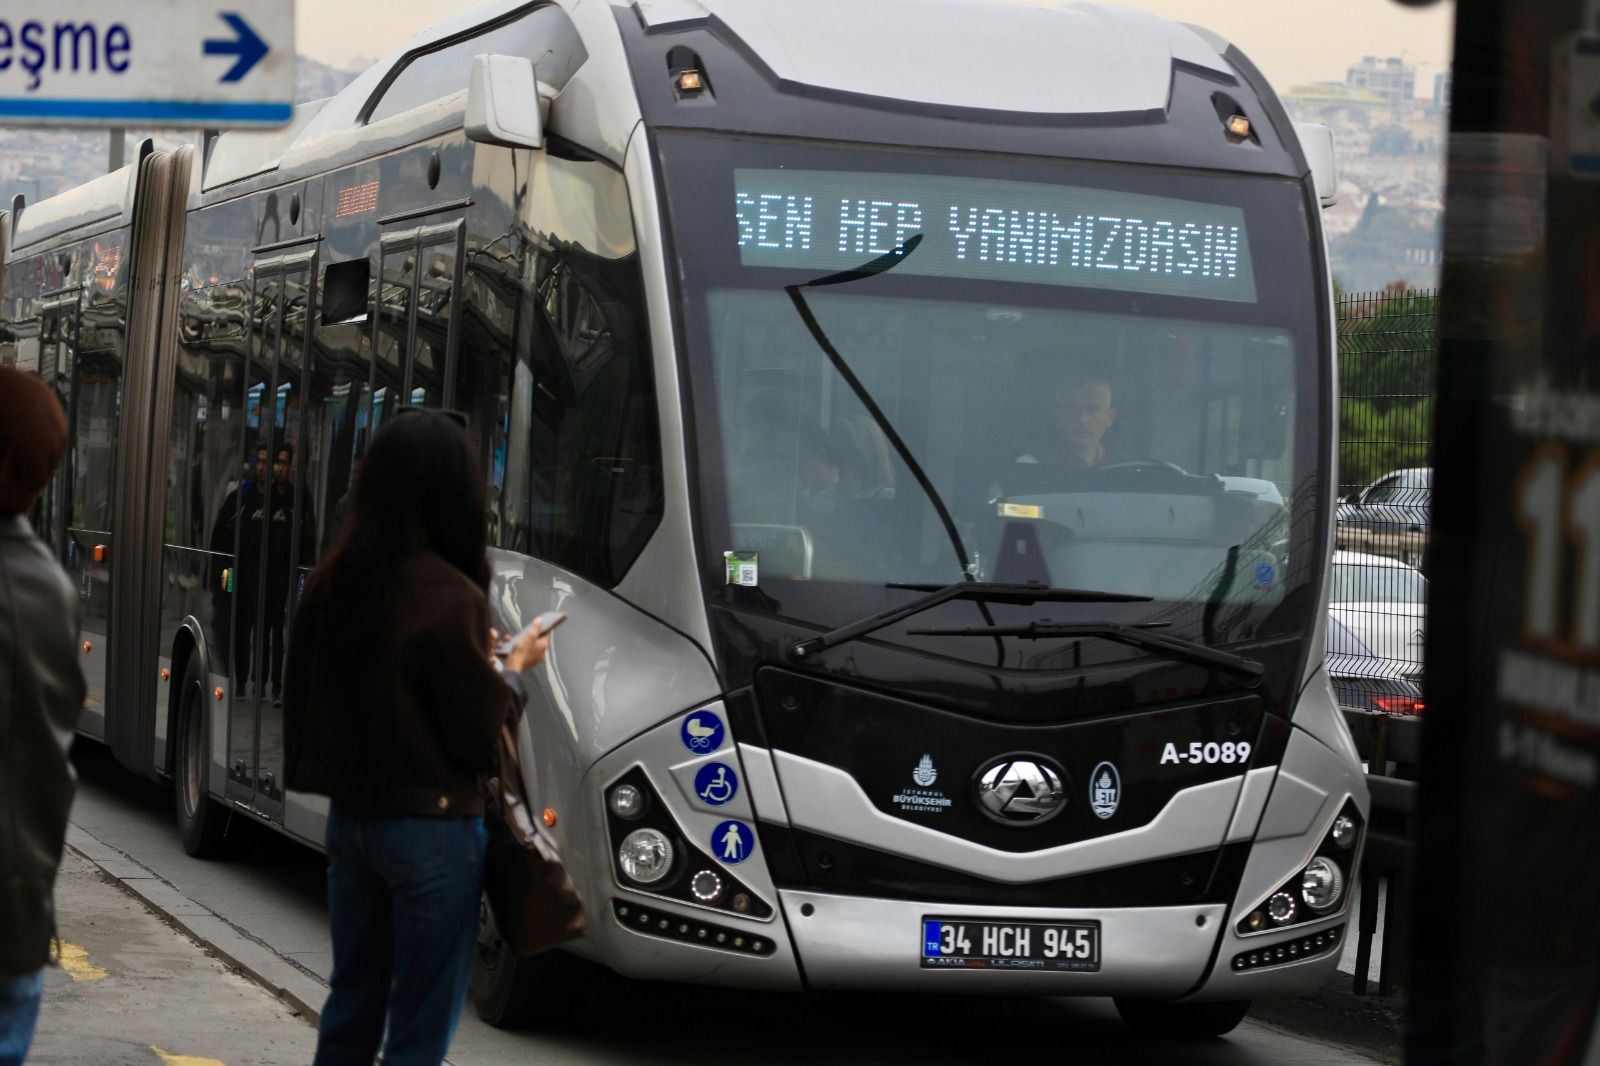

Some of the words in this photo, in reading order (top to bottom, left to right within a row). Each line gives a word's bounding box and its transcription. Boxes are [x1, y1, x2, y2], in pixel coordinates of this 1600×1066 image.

[736, 193, 812, 249] SEN
[838, 199, 922, 255] HEP
[949, 206, 1238, 277] YANIMIZDASIN
[1160, 741, 1251, 764] A-5089
[927, 942, 938, 951] TR
[940, 925, 971, 954] 34
[982, 926, 1030, 957] HCH
[1043, 928, 1090, 959] 945
